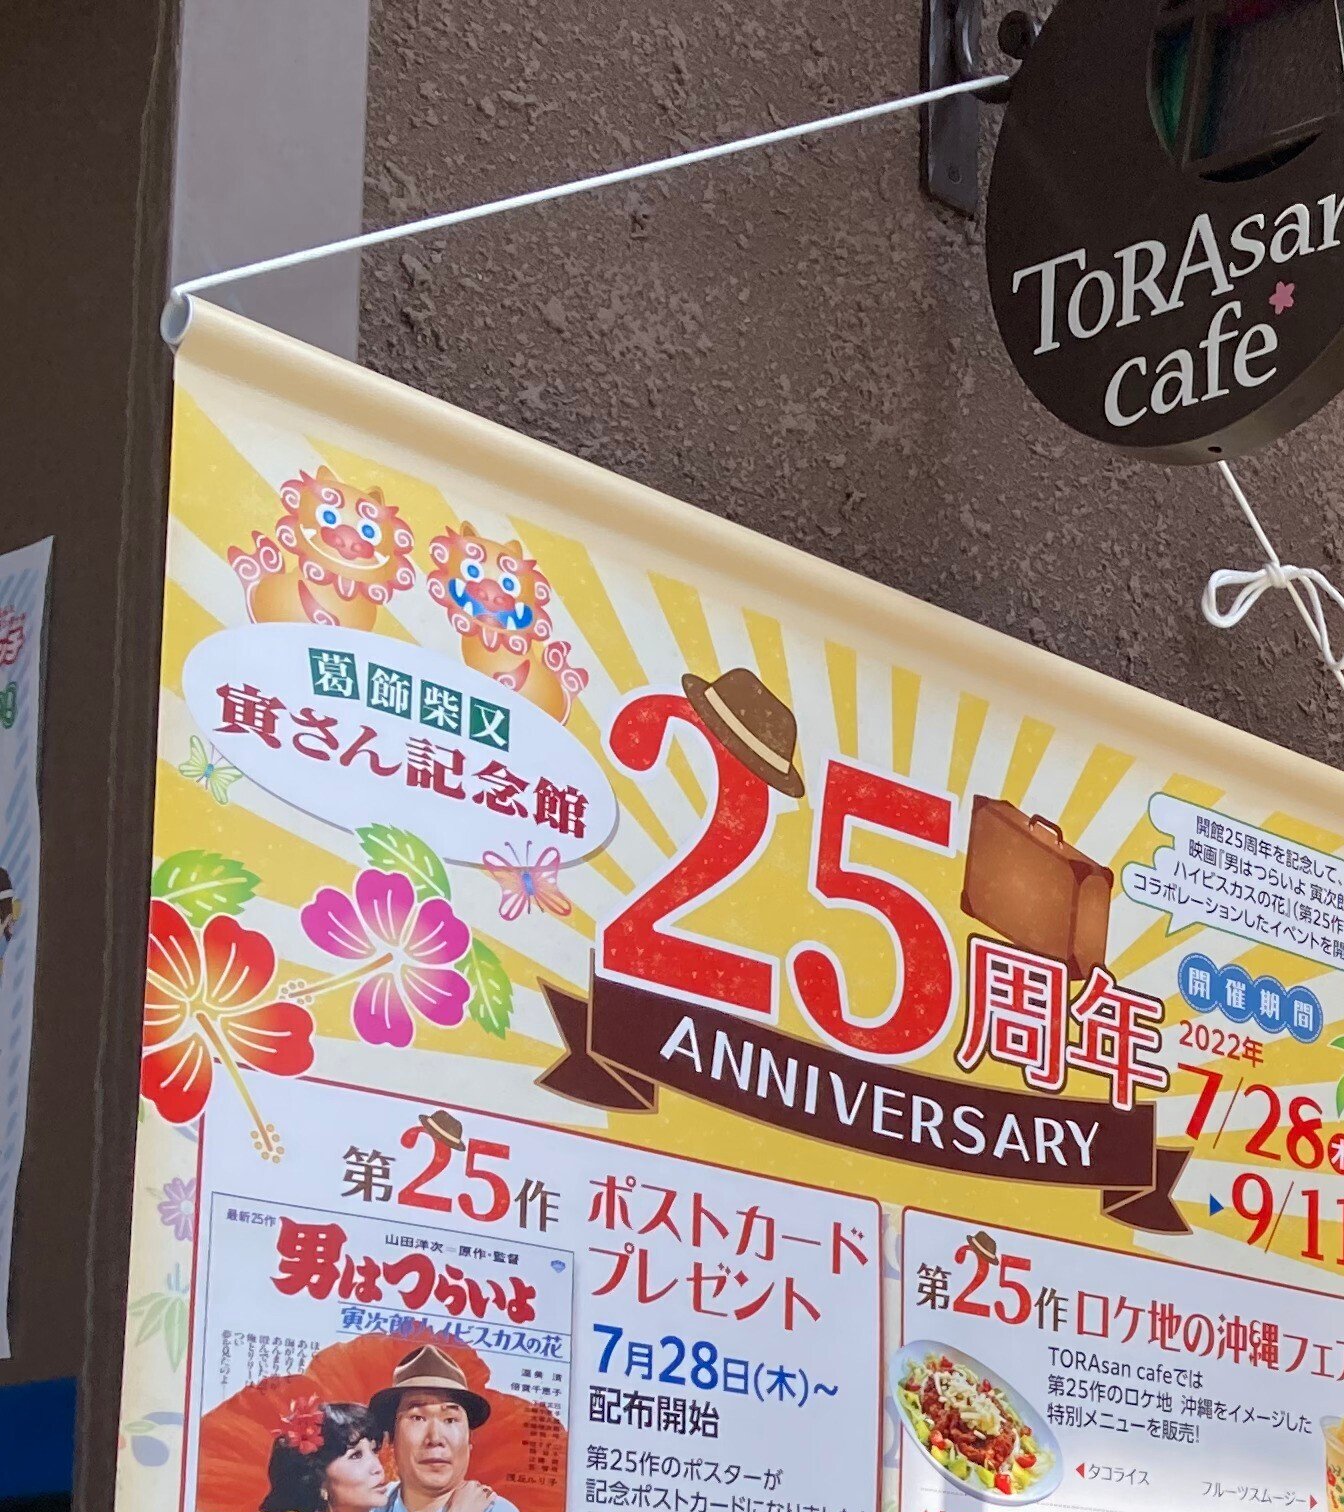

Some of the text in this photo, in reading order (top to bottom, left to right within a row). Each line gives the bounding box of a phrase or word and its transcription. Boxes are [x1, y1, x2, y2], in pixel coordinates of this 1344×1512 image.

[1103, 301, 1278, 428] cafe
[310, 649, 509, 750] 葛飾柴又
[213, 683, 589, 839] 寅さん記念館
[1188, 966, 1315, 1031] 開催期間
[1179, 1020, 1264, 1068] 2022年
[659, 1016, 1100, 1167] ANNIVERSARY
[342, 1125, 561, 1233] 第25作
[588, 1175, 869, 1274] ポストカード
[270, 1216, 537, 1324] 男はつらいよ
[588, 1242, 821, 1331] プレゼント
[1048, 1346, 1203, 1390] TORAsan cafeでは
[589, 1384, 720, 1439] 配布開始
[1046, 1403, 1201, 1445] 特別メニューを販売!
[1047, 1374, 1313, 1435] 第25作のロケ地 沖縄をイメージした
[586, 1444, 783, 1491] 第25作のポスターが
[1088, 1461, 1149, 1486] タコライス
[1200, 1480, 1308, 1508] フルーツスムージー
